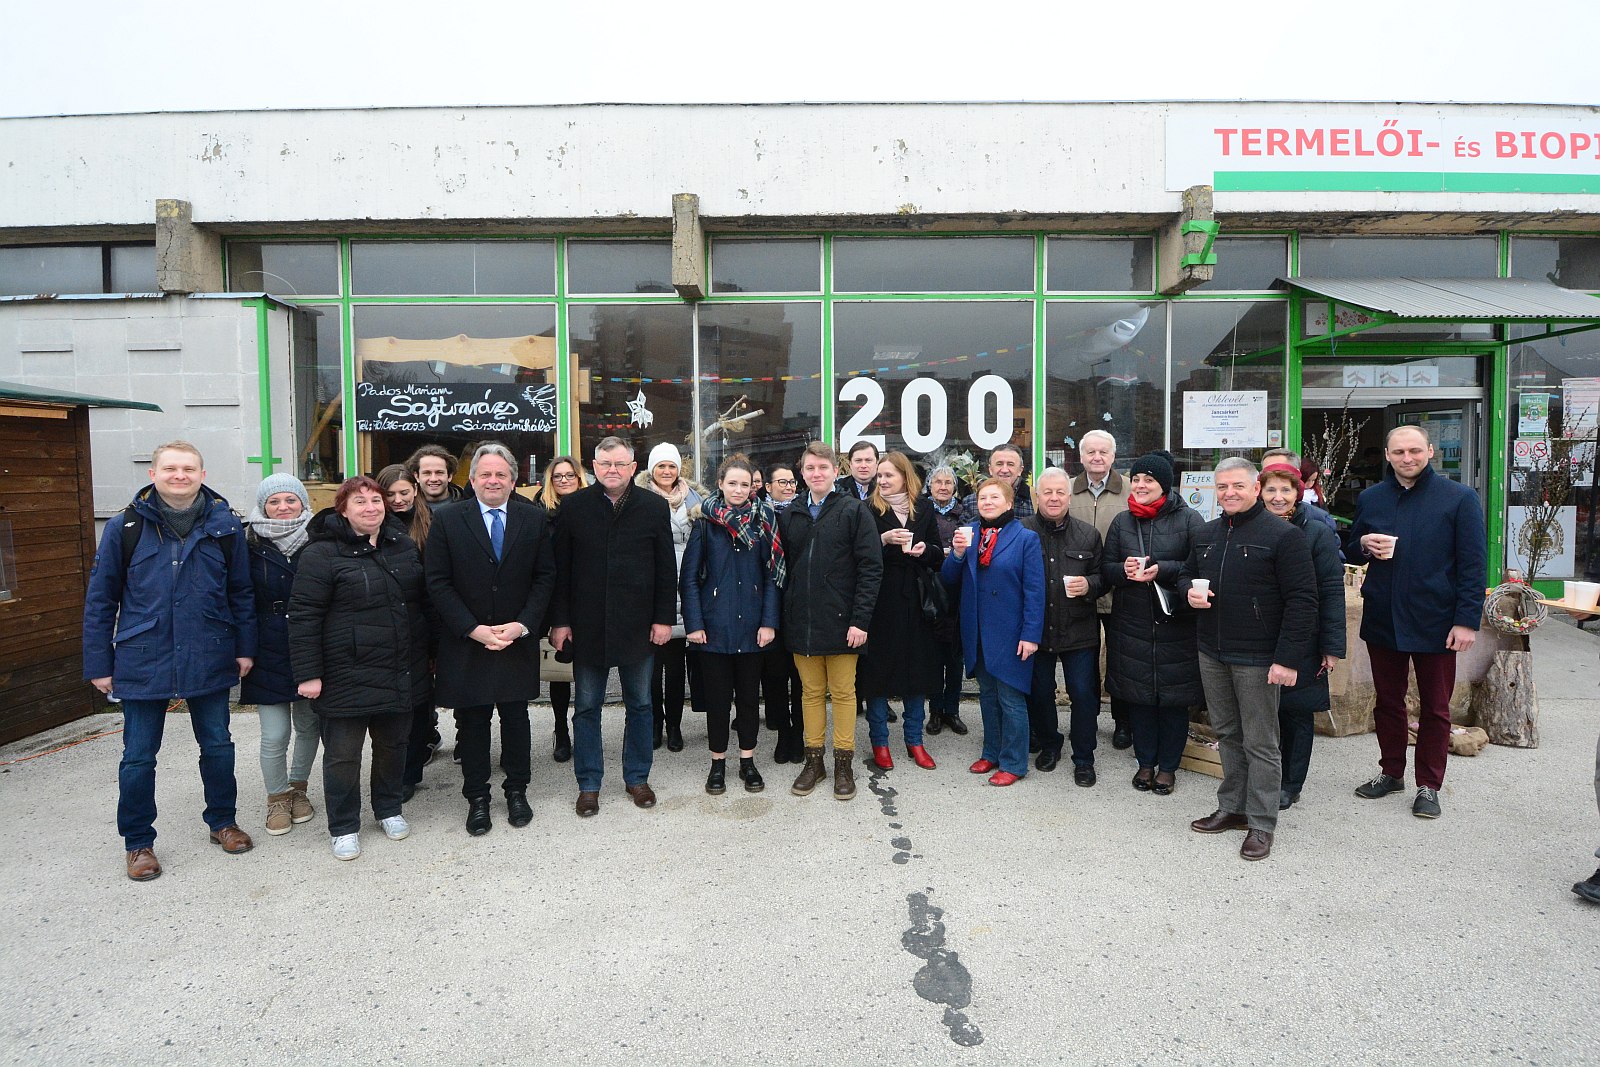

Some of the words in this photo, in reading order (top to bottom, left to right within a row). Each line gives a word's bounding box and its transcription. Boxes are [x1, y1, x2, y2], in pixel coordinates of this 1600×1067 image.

[1214, 119, 1440, 157] TERMELŐI-
[1454, 136, 1481, 158] ÉS
[358, 382, 401, 397] Pados
[377, 388, 519, 427] Sajtvarázs
[1207, 394, 1244, 403] Oklevél
[838, 375, 1014, 454] 200
